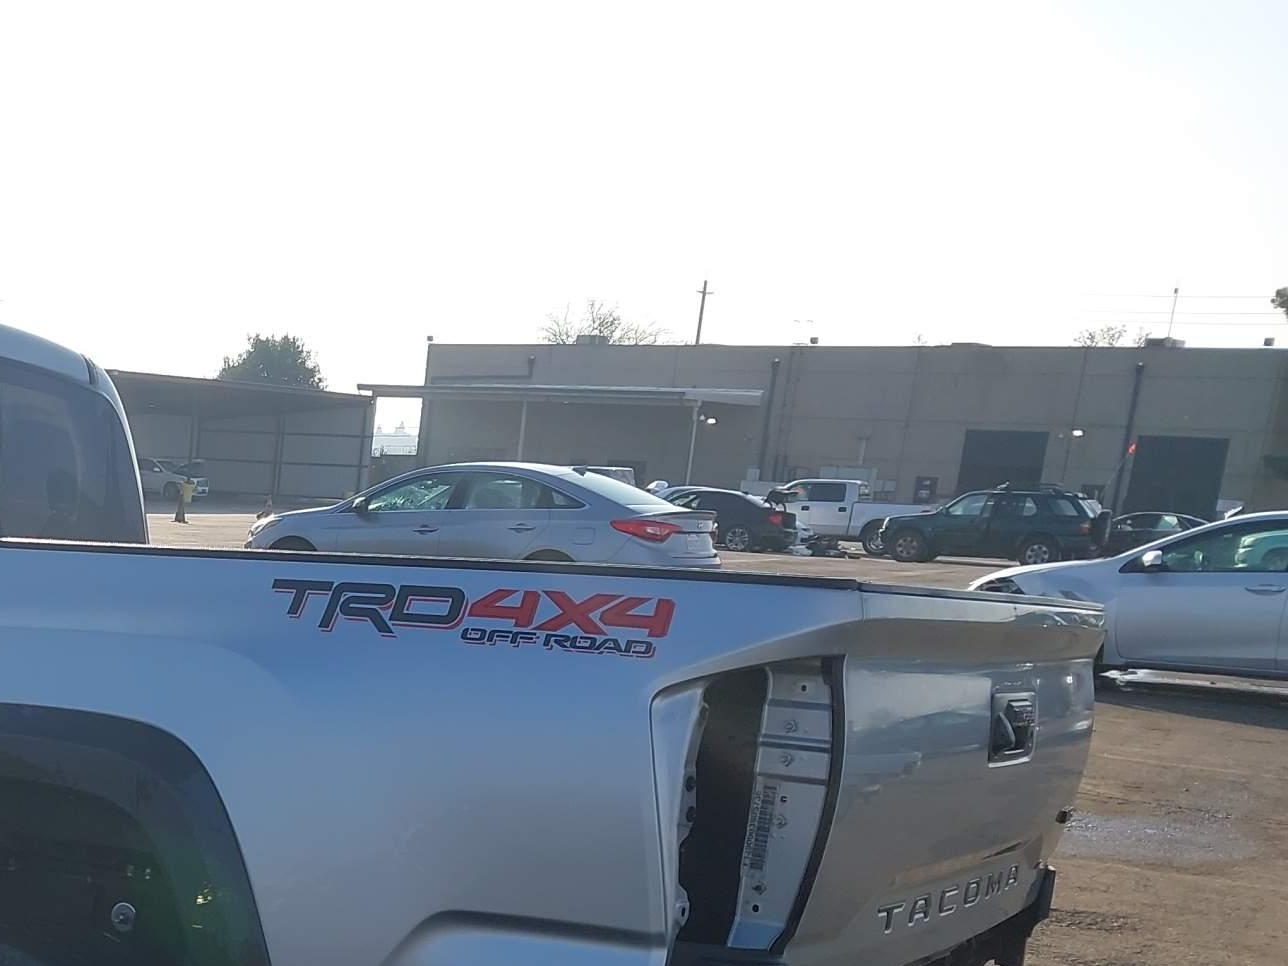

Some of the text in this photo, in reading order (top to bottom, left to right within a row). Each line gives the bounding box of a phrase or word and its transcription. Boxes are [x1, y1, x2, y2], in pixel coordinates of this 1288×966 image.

[272, 578, 676, 638] TRD 4X4
[460, 626, 656, 658] OFF ROAD
[877, 864, 1019, 934] TACOMA
